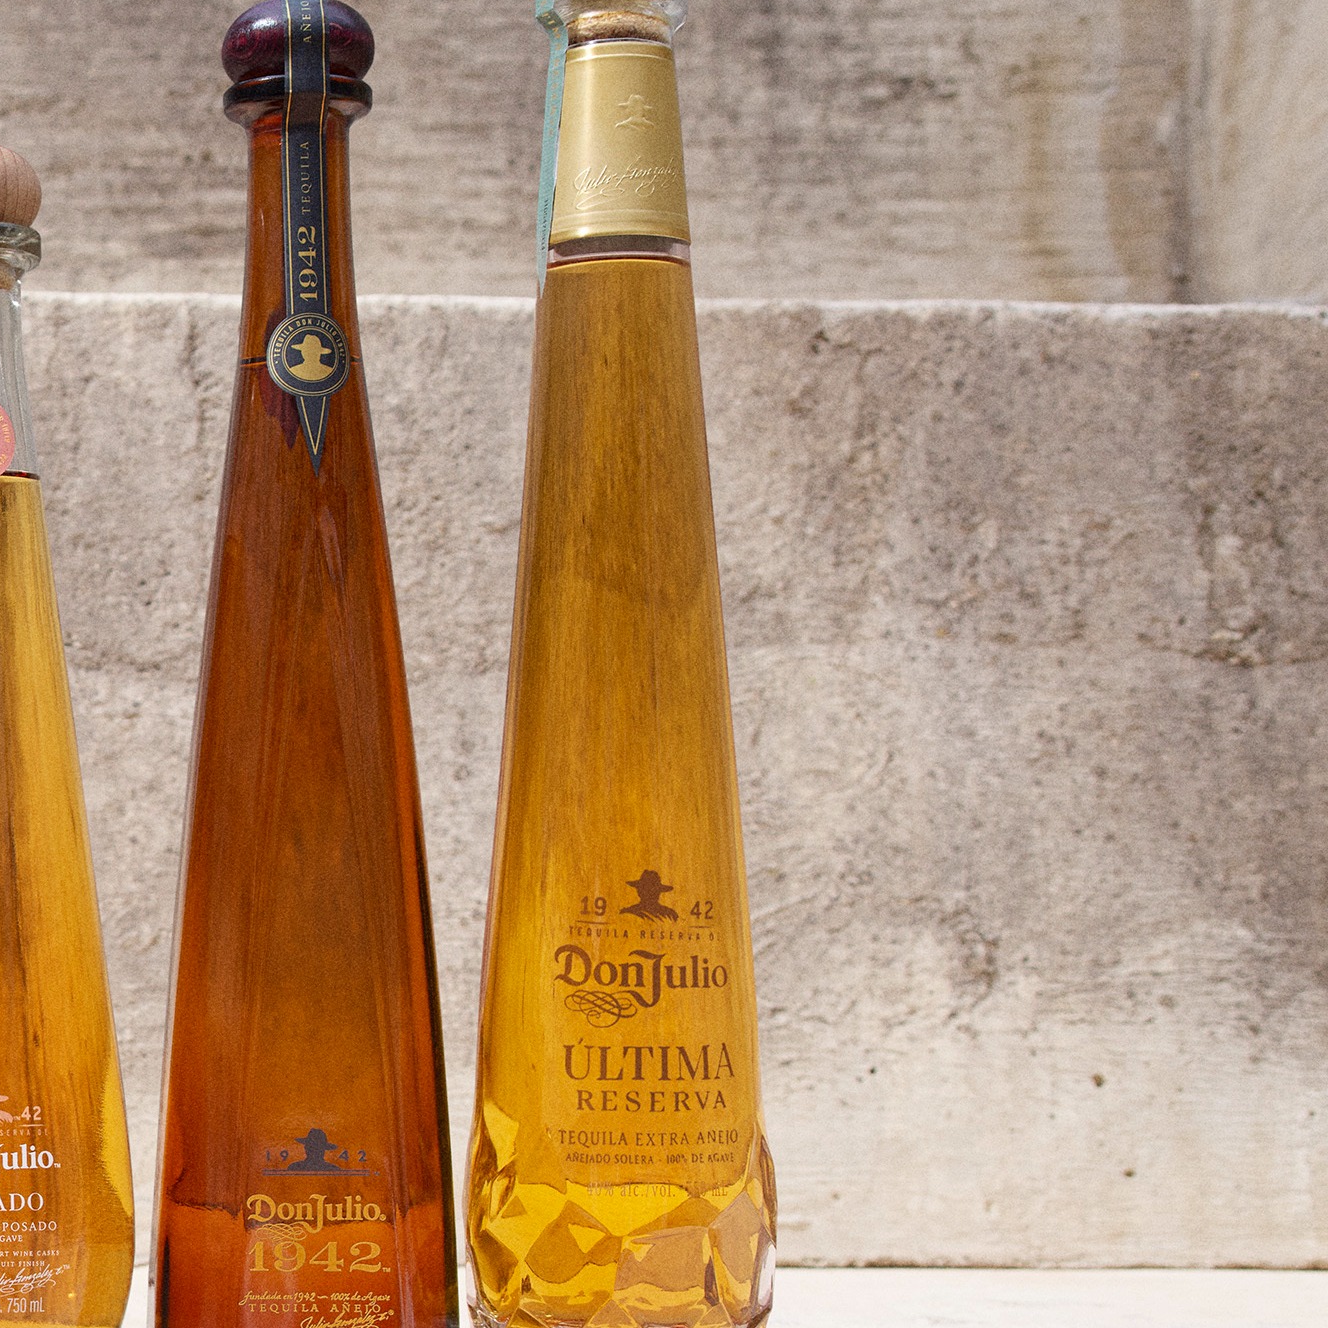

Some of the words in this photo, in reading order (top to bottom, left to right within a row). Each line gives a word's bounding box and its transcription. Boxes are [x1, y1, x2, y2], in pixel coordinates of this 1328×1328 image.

[301, 0, 312, 44] AÑEJO
[301, 140, 311, 215] TEQUILA
[296, 225, 319, 302] 1942
[273, 325, 294, 357] TEQUILA
[295, 318, 313, 327] DON
[316, 319, 337, 336] JULIO
[580, 896, 607, 917] 19
[690, 900, 714, 920] 42
[568, 925, 629, 939] TEQUILA
[563, 1038, 735, 1081] ÚLTIMA
[576, 1090, 727, 1113] RESERVA
[20, 1105, 42, 1121] 42
[558, 1129, 628, 1149] TEQUILA
[635, 1132, 690, 1147] EXTRA
[265, 1150, 289, 1162] 19
[338, 1150, 367, 1162] 42
[565, 1151, 611, 1165] AÑEJADO
[614, 1153, 654, 1165] SOLERA
[691, 1153, 705, 1163] DE
[707, 1152, 734, 1163] AGAVE
[248, 1241, 382, 1273] 1942
[7, 1297, 27, 1313] 750
[29, 1297, 45, 1312] mL
[238, 1290, 282, 1306] fundada
[293, 1292, 316, 1303] 1942
[330, 1292, 350, 1302] 100%
[350, 1291, 361, 1301] de
[361, 1291, 391, 1306] Agave
[249, 1303, 319, 1314] TEQUILA
[329, 1300, 381, 1314] AÑEJO
